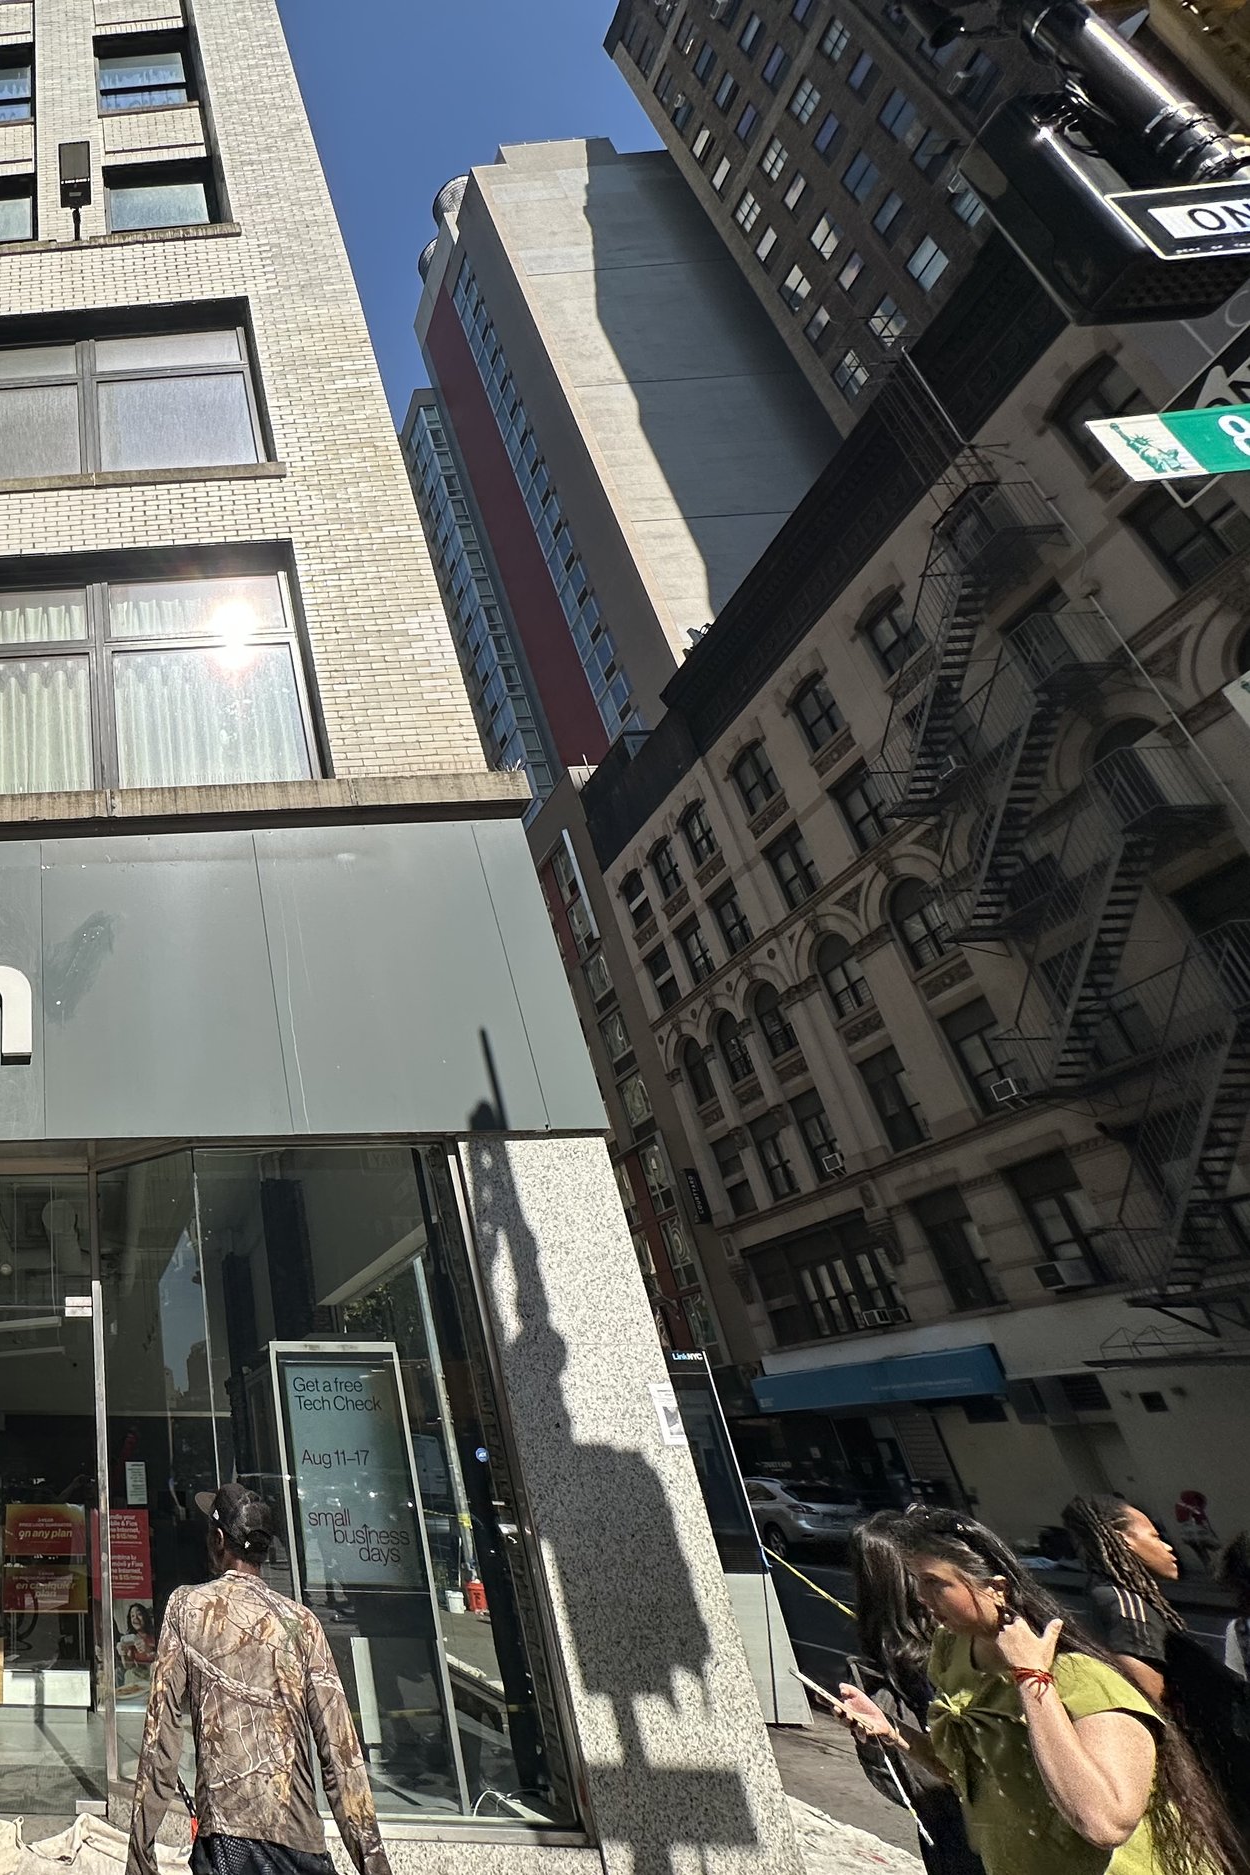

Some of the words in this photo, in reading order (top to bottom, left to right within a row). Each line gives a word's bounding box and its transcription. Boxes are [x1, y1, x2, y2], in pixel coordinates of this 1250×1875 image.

[672, 1352, 703, 1360] LinkNYC
[293, 1377, 319, 1392] Get
[323, 1381, 332, 1392] a
[334, 1377, 363, 1392] free
[294, 1395, 331, 1411] Tech
[333, 1395, 382, 1411] Check
[302, 1450, 332, 1468] Aug
[308, 1508, 351, 1527] small
[32, 1530, 51, 1539] any
[51, 1528, 73, 1539] plan
[333, 1523, 411, 1546] business
[359, 1546, 401, 1566] days
[35, 1590, 57, 1599] plan
